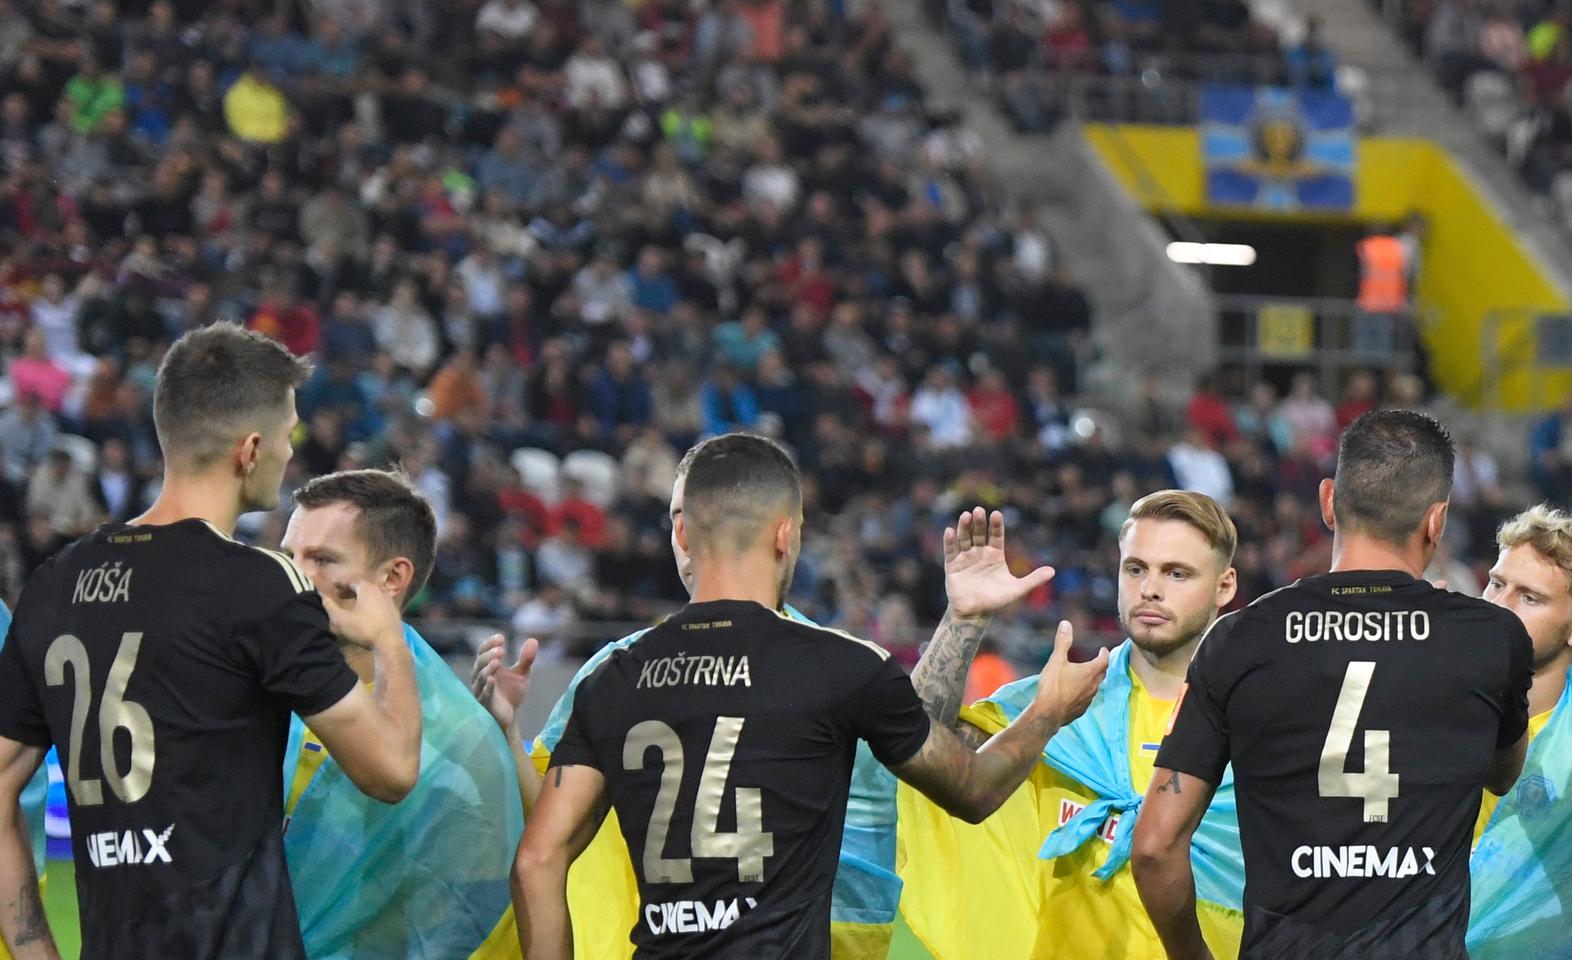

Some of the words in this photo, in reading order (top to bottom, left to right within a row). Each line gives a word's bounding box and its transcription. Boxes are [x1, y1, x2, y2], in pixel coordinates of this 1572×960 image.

[72, 561, 133, 604] KÓŠA
[1285, 610, 1430, 643] GOROSITO
[636, 651, 751, 689] KOŠTRNA
[44, 631, 155, 806] 26
[1318, 661, 1399, 823] 4
[622, 716, 774, 884] 24
[645, 897, 757, 935] CINEMA
